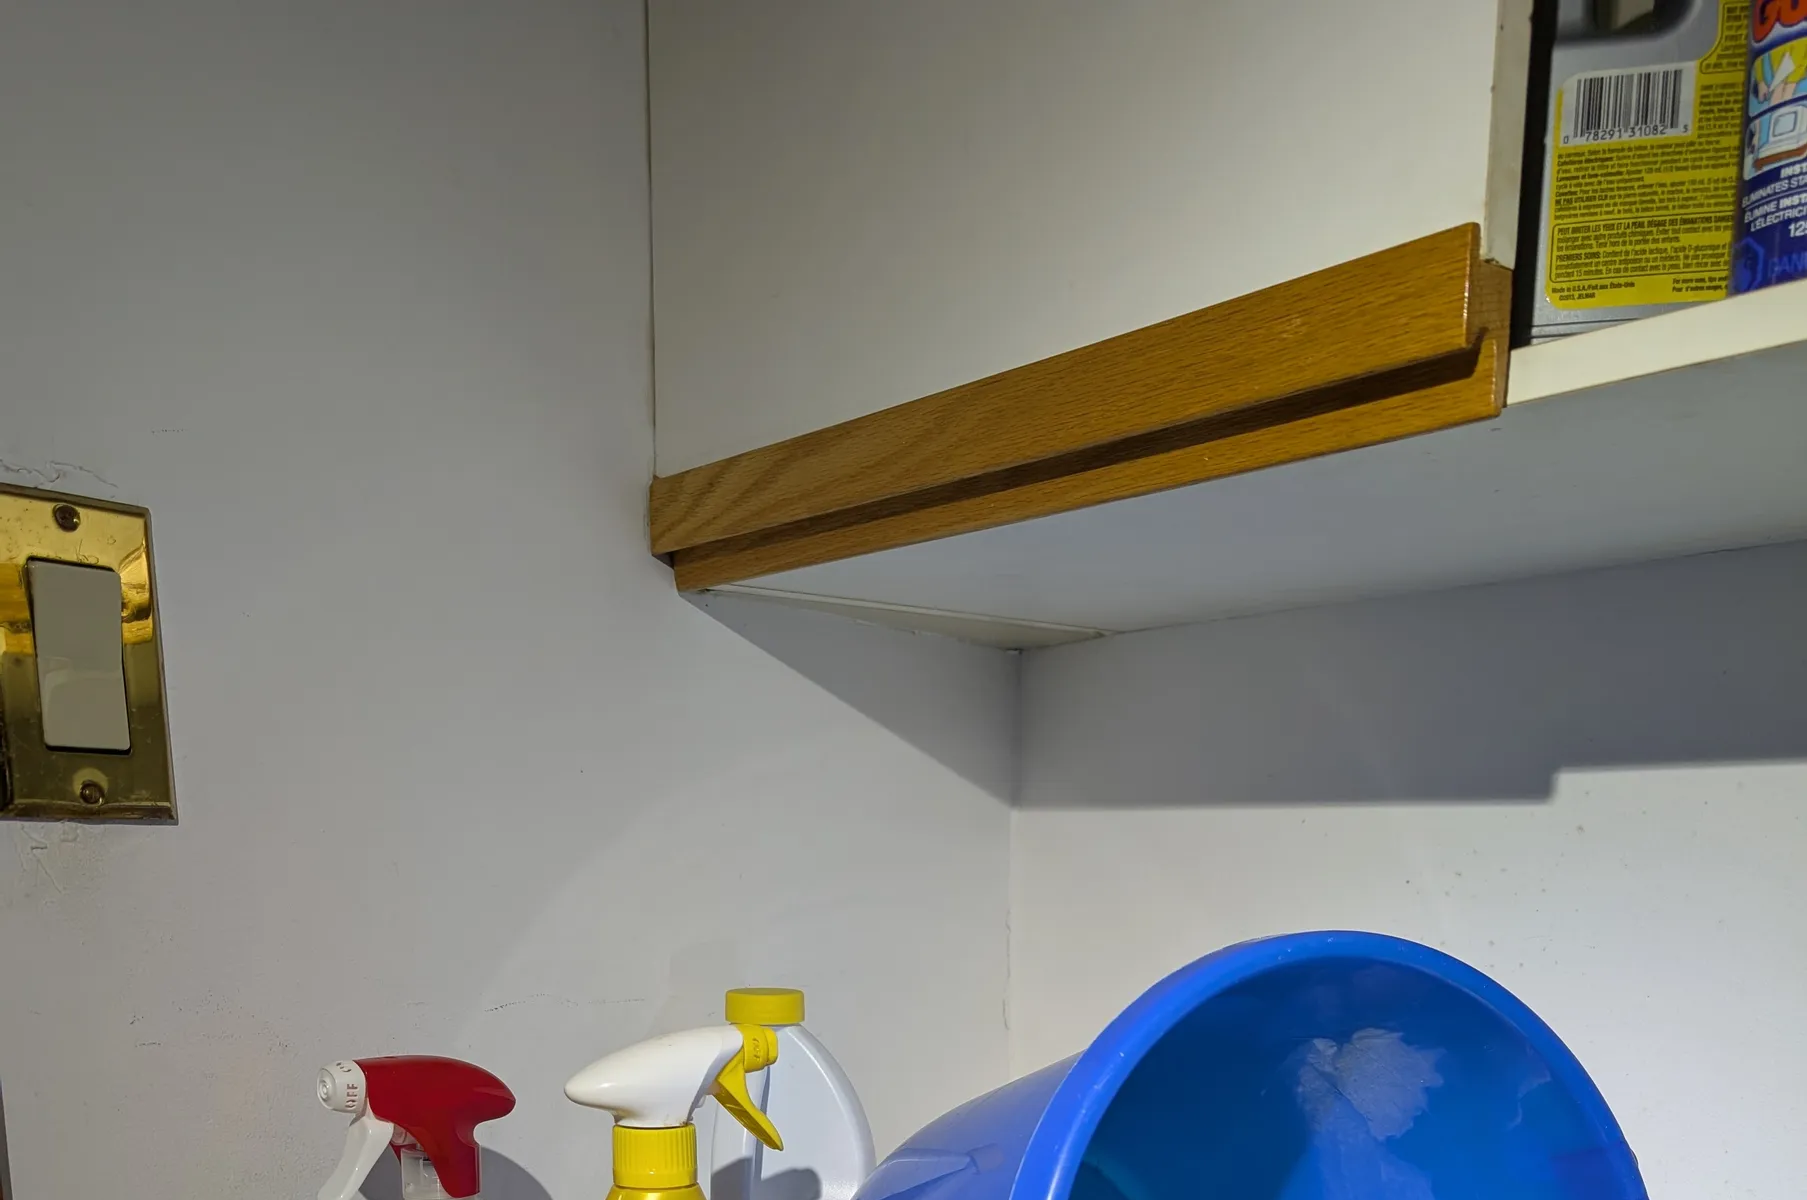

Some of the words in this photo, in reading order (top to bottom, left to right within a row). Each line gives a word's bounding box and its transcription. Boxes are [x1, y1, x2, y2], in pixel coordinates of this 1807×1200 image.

[1563, 136, 1569, 144] 0
[1586, 127, 1621, 141] 78291
[1629, 125, 1666, 137] 31082
[1683, 125, 1689, 133] 5
[345, 1084, 358, 1108] OFF
